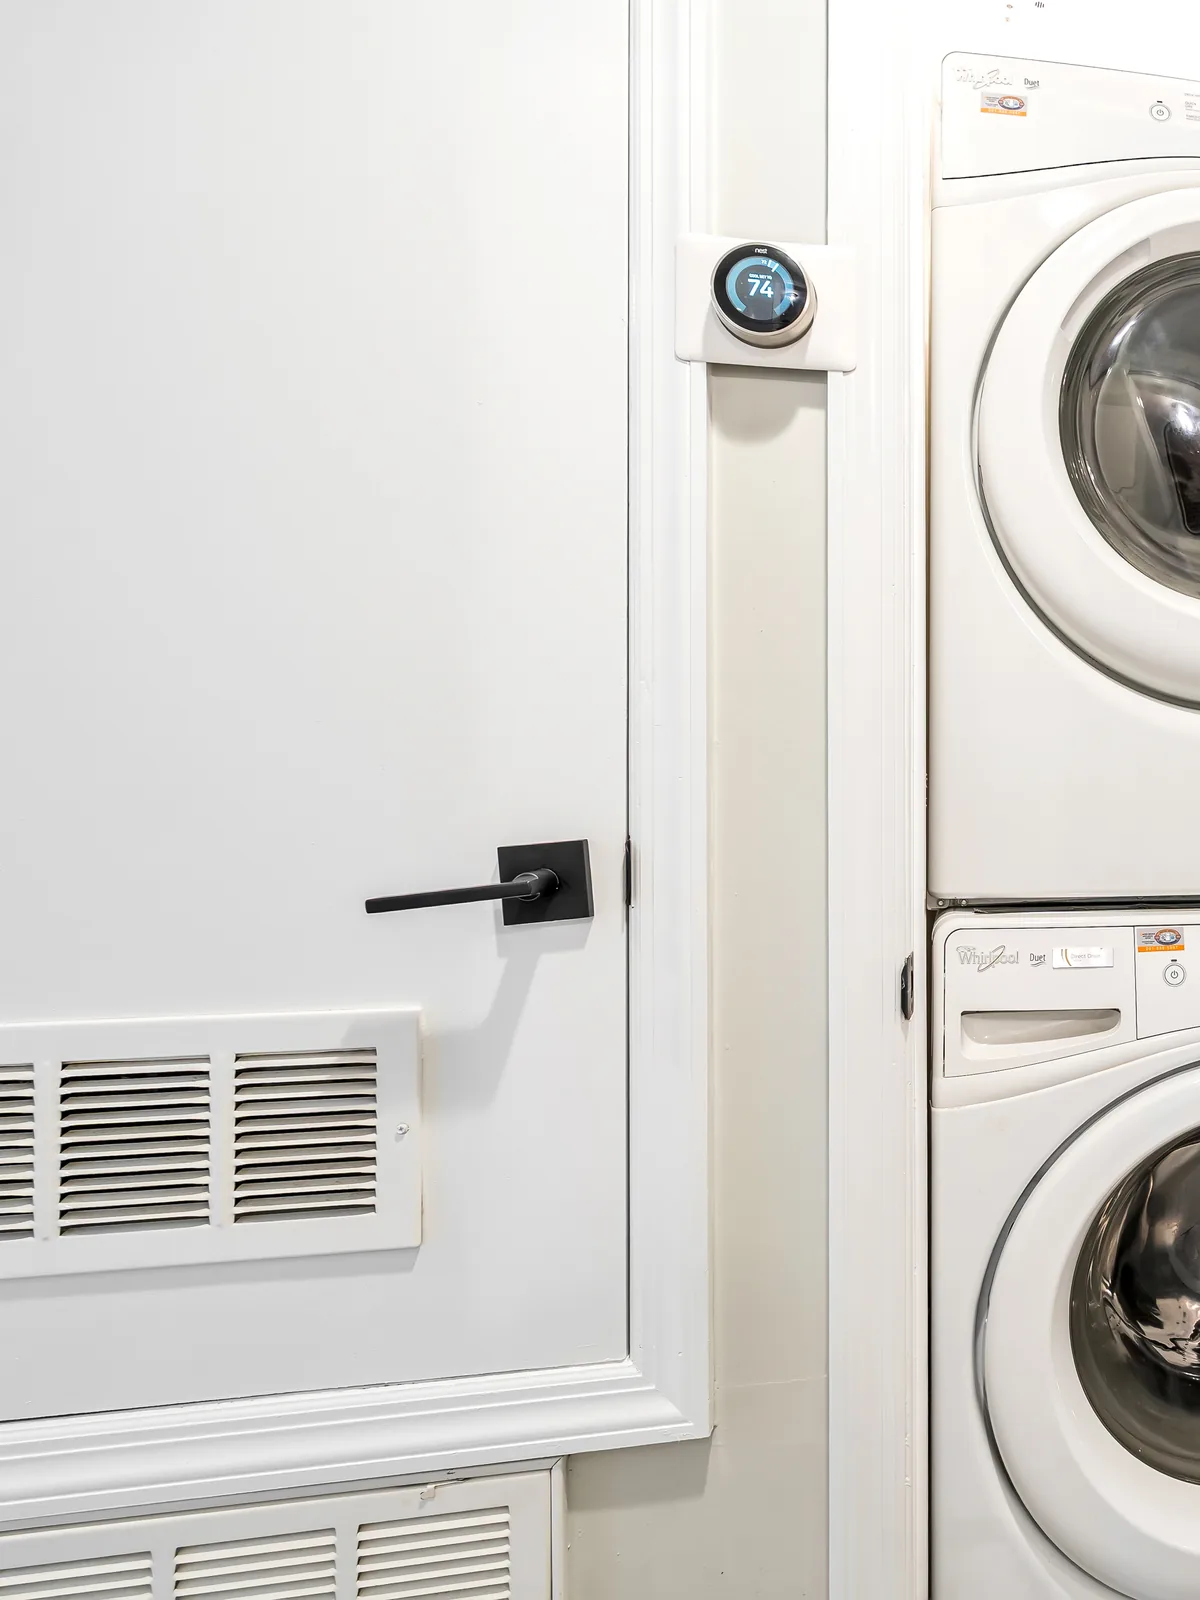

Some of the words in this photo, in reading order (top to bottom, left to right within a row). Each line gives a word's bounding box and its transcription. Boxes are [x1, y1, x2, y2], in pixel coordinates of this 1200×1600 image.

[1024, 77, 1040, 88] Duet
[754, 247, 768, 255] nest
[747, 278, 774, 299] 74
[956, 945, 1020, 973] Whirlpool
[1029, 953, 1046, 966] Duet
